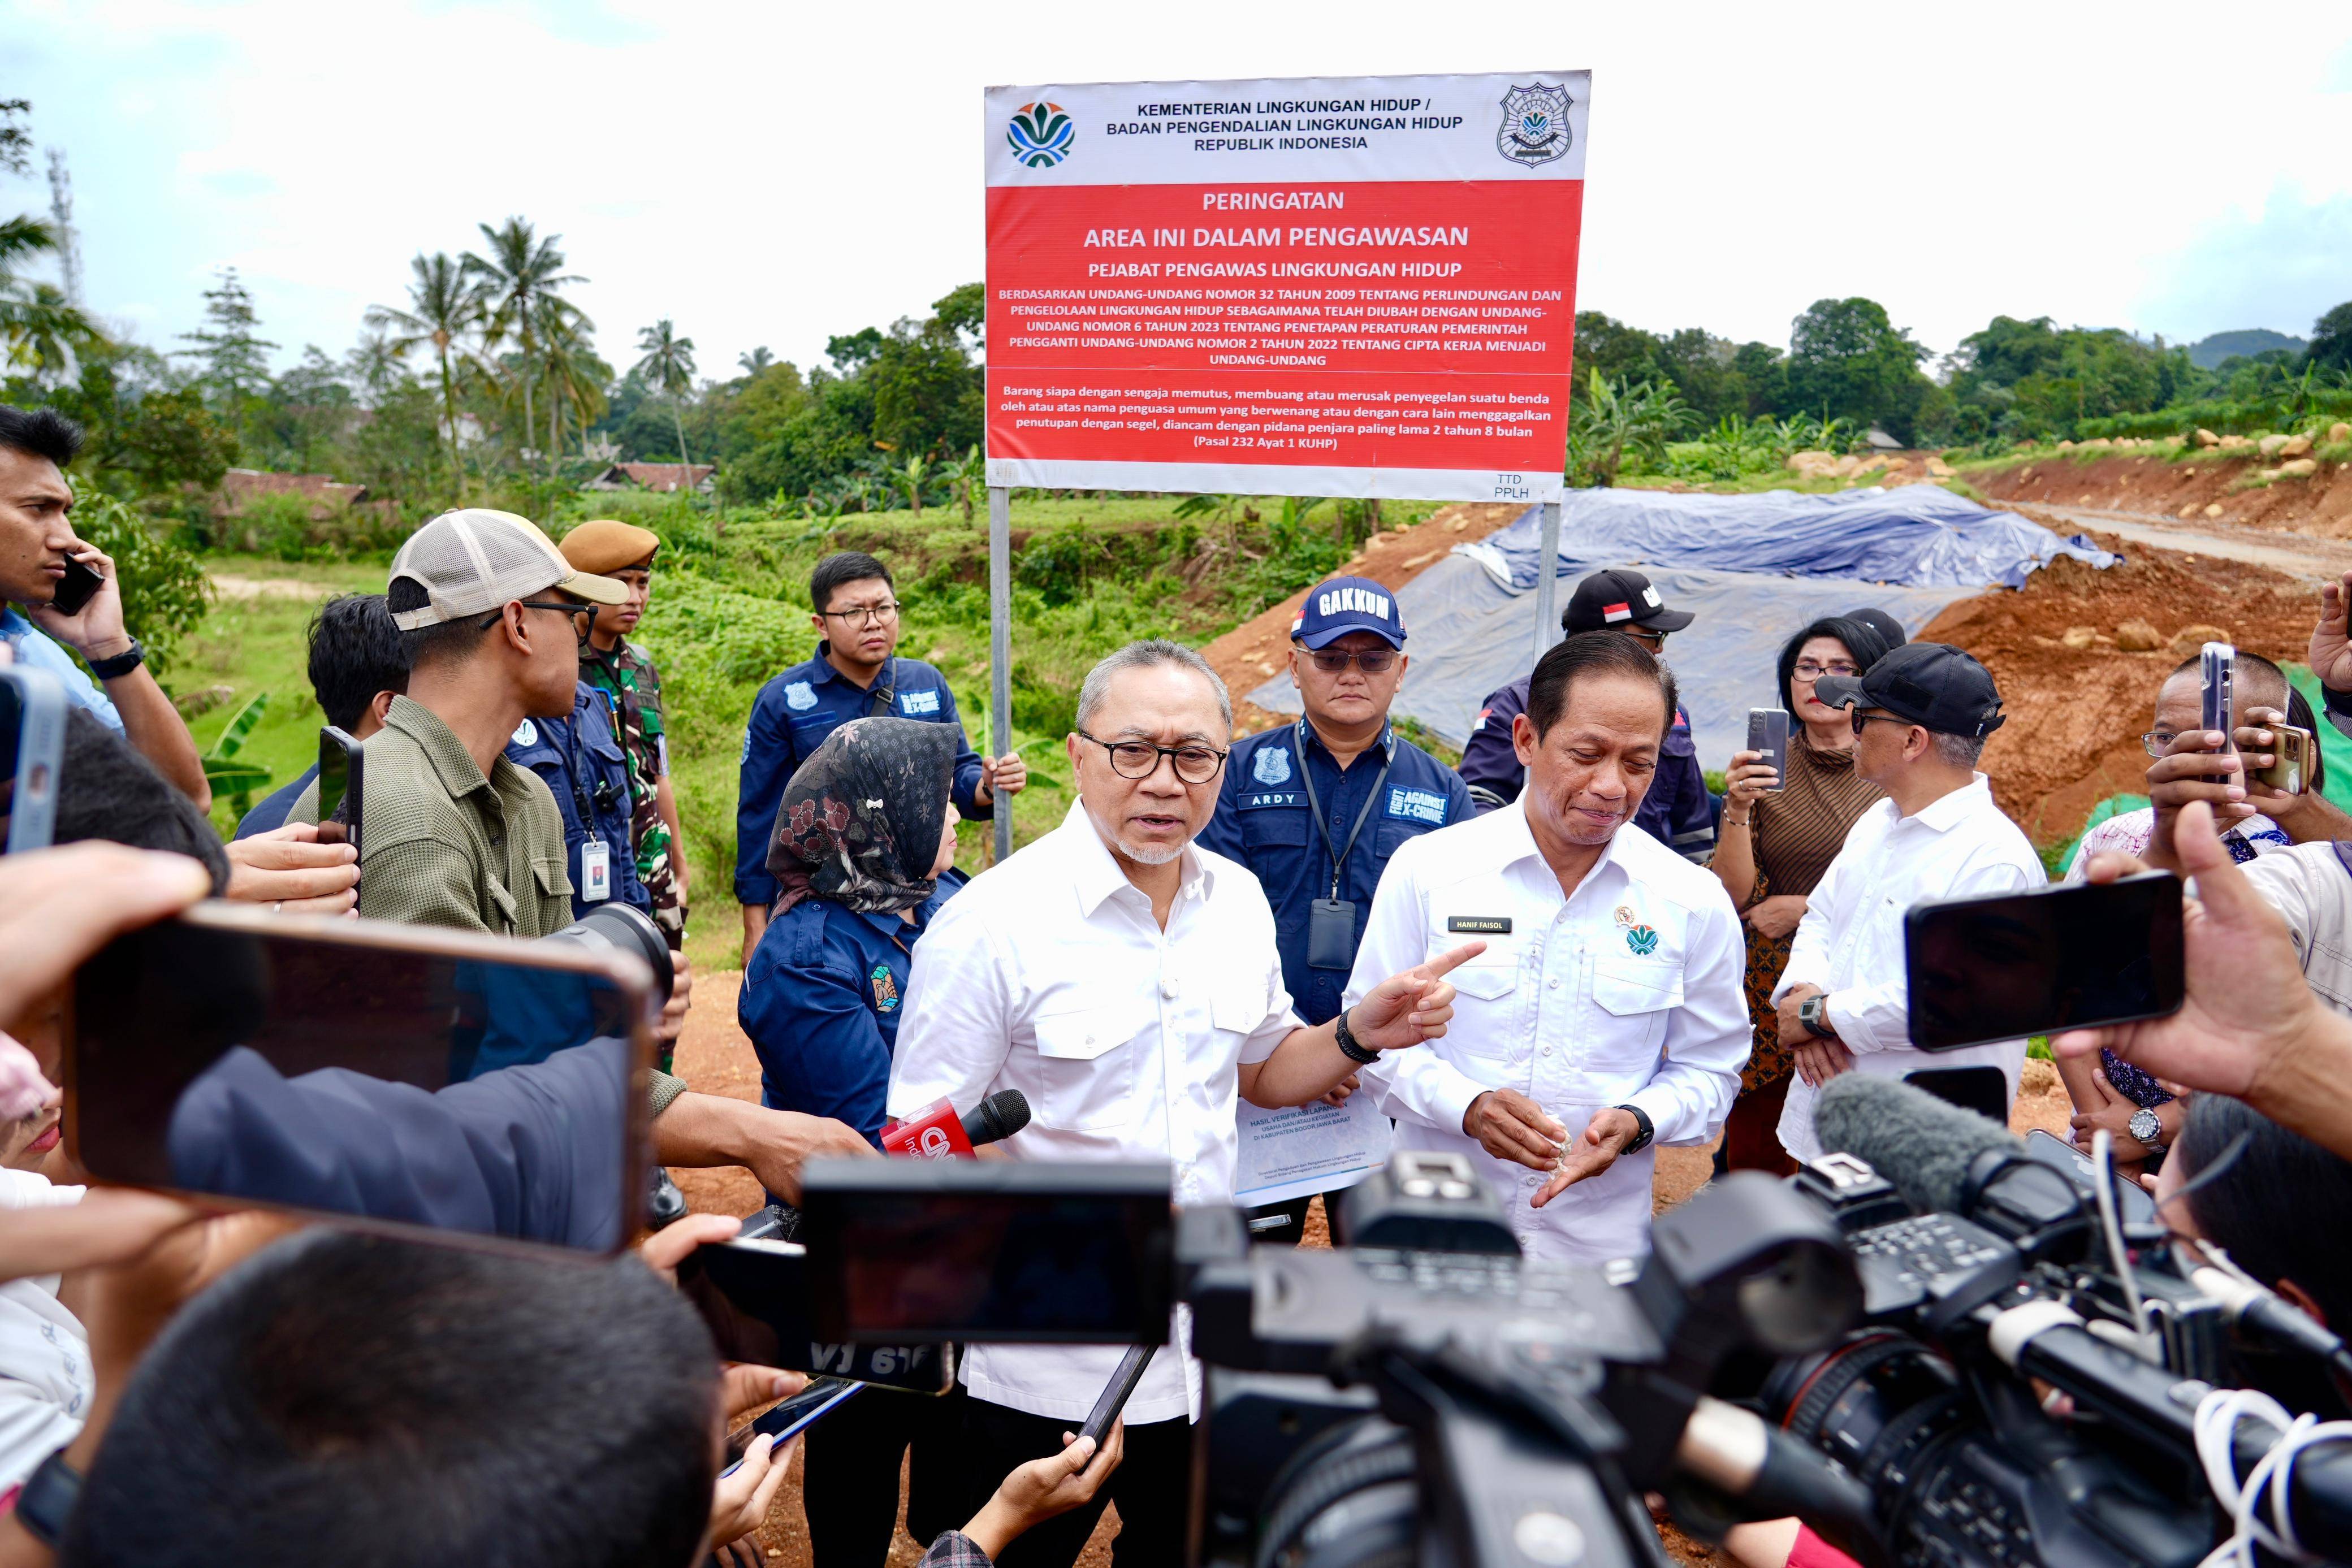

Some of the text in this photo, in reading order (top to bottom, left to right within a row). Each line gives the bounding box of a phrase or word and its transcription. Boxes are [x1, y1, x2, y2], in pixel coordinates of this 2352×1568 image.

[1522, 93, 1551, 102] PPLH
[1138, 98, 1430, 116] KEMENTERIAN LINGKUNGAN HIDUP /
[1107, 116, 1463, 135] BADAN PENGENDALIAN LINGKUNGAN HIDUP
[1195, 137, 1368, 151] REPUBLIK INDONESIA
[1203, 192, 1343, 210] PERINGATAN
[1084, 227, 1468, 247] AREA INI DALAM PENGAWASAN
[1089, 263, 1462, 277] PEJABAT PENGAWAS LINGKUNGAN HIDUP
[999, 289, 1561, 301] BERDASARKAN UNDANG-UNDANG NOMOR 32 TAHUN 2009 TENTANG PERLINDUNGAN DAN
[1011, 306, 1547, 318] PENGELOLAAN LINGKUNGAN HIDUP SEBAGAIMANA TELAH DIUBAH DENGAN UNDANG-
[1027, 322, 1527, 334] UNDANG NOMOR 6 TAHUN 2023 TENTANG PENETAPAN PERATURAN PEMERINTAH
[1010, 337, 1546, 351] PENGGANTI UNDANG-UNDANG NOMOR 2 TAHUN 2022 TENTANG CIPTA KERJA MENJADI
[1210, 355, 1326, 365] UNDANG-UNDANG
[1004, 386, 1549, 404] Barang siapa dengan sengaja memutus, membuang atau merusak penyegelan suatu benda
[1001, 401, 1026, 411] oleh
[1028, 402, 1054, 412] atau
[1057, 403, 1081, 412] atas
[1119, 405, 1175, 415] penguasa
[1220, 407, 1248, 417] yang
[1251, 405, 1320, 418] berwenang
[1322, 408, 1350, 417] atau
[1354, 407, 1399, 419] dengan
[1432, 408, 1455, 418] lain
[1459, 410, 1551, 422] menggagalkan
[1016, 418, 1532, 436] penutupan dengan segel, diancam dengan pidana penjara paling lama 2 tahun 8 bulan
[1194, 436, 1337, 451] (Pasal 232 Ayat 1 KUHP)
[1498, 474, 1521, 484] TTD
[1495, 487, 1529, 498] PPLH
[1319, 587, 1389, 621] GAKKUM
[1252, 794, 1294, 805] ARDY
[1389, 789, 1406, 815] FIGHT
[1404, 791, 1446, 811] AGAINST
[1402, 802, 1445, 824] X-CRIME
[1272, 1110, 1308, 1122] VERIFIKASI
[1310, 1102, 1348, 1115] LAPANN
[1282, 1117, 1311, 1128] DAN/ATAU
[1311, 1111, 1340, 1121] KEGIATAN
[1261, 1128, 1294, 1139] KABUPATEN
[1295, 1124, 1316, 1133] BOGOR
[1333, 1116, 1351, 1125] BARAT
